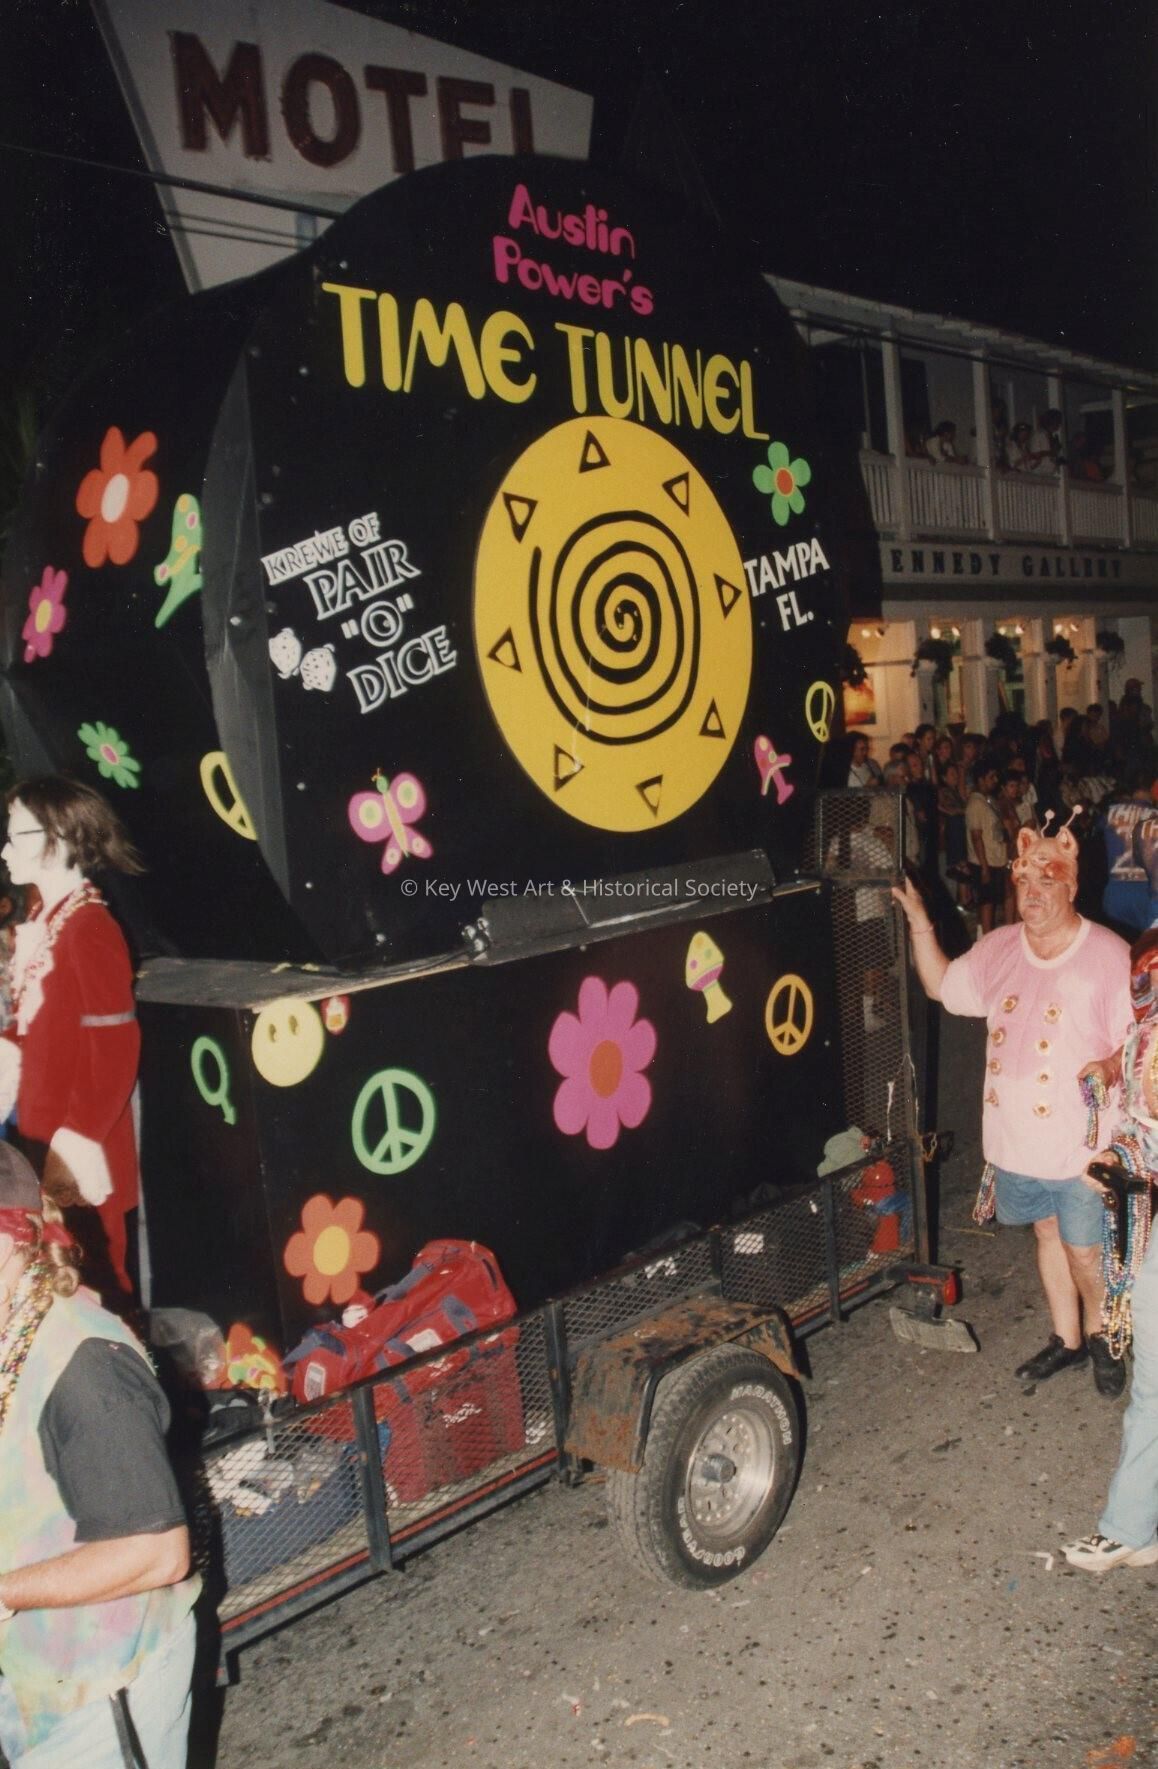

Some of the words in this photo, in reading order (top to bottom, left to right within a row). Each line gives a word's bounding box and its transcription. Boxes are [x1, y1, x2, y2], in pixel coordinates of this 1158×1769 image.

[508, 183, 636, 259] Austin
[492, 235, 655, 316] Power's
[321, 282, 537, 404] TIME
[554, 322, 770, 441] TUNNEL
[260, 525, 350, 586] KREWE
[348, 511, 382, 547] OF
[302, 539, 422, 621] PAIR
[743, 537, 831, 597] TAMPA
[891, 549, 1001, 575] ENNEDY
[1022, 555, 1121, 579] GALLERY
[340, 593, 415, 647] "O"
[776, 591, 815, 631] FL.
[346, 624, 458, 715] DICE
